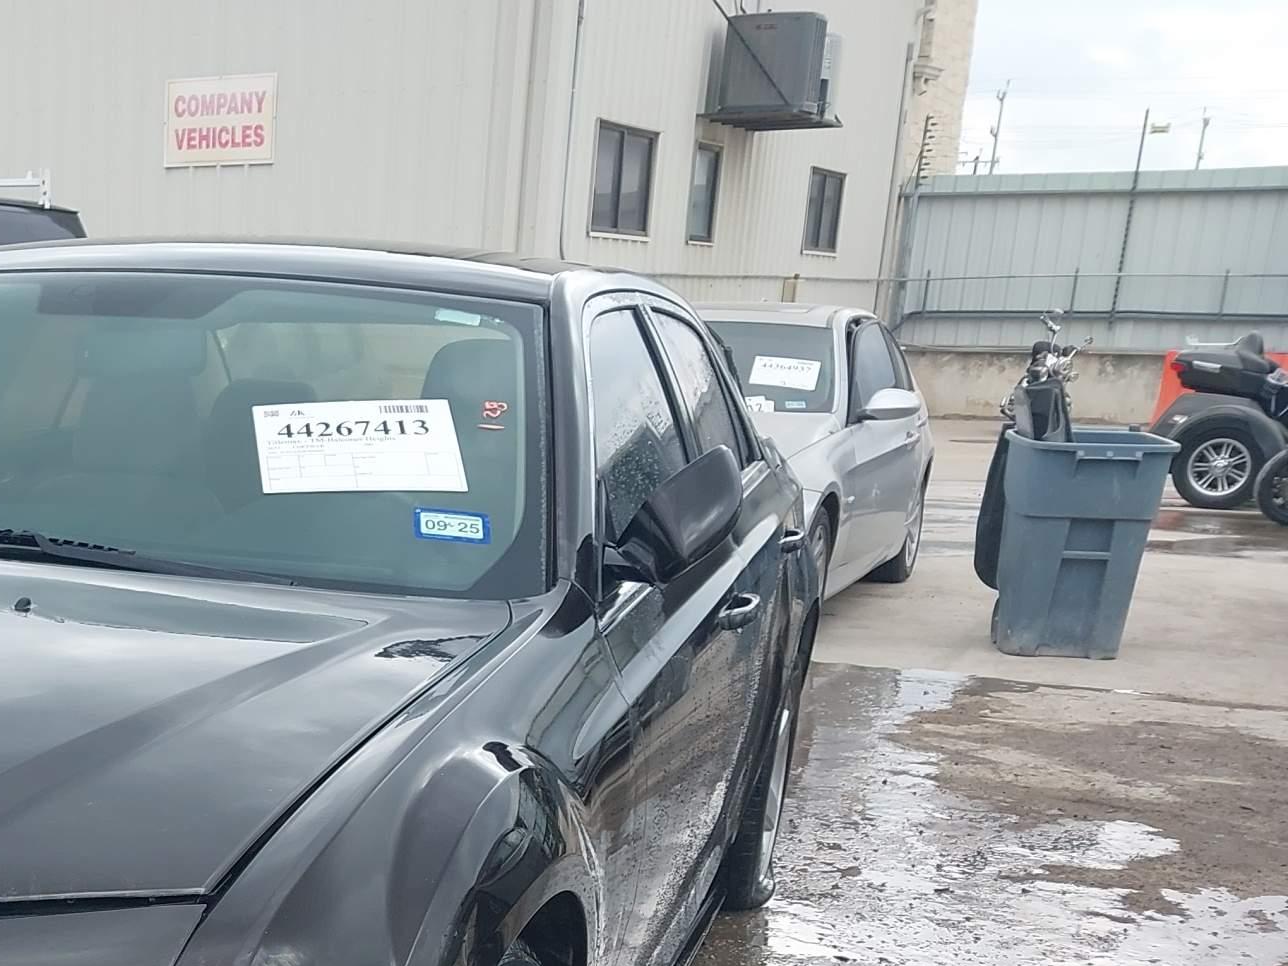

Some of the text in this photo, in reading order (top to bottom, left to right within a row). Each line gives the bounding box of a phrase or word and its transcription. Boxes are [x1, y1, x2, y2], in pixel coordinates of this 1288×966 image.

[174, 90, 266, 118] COMPANY
[174, 124, 265, 151] VEHICLES
[277, 419, 430, 438] 44267413
[425, 519, 480, 534] 09 25
